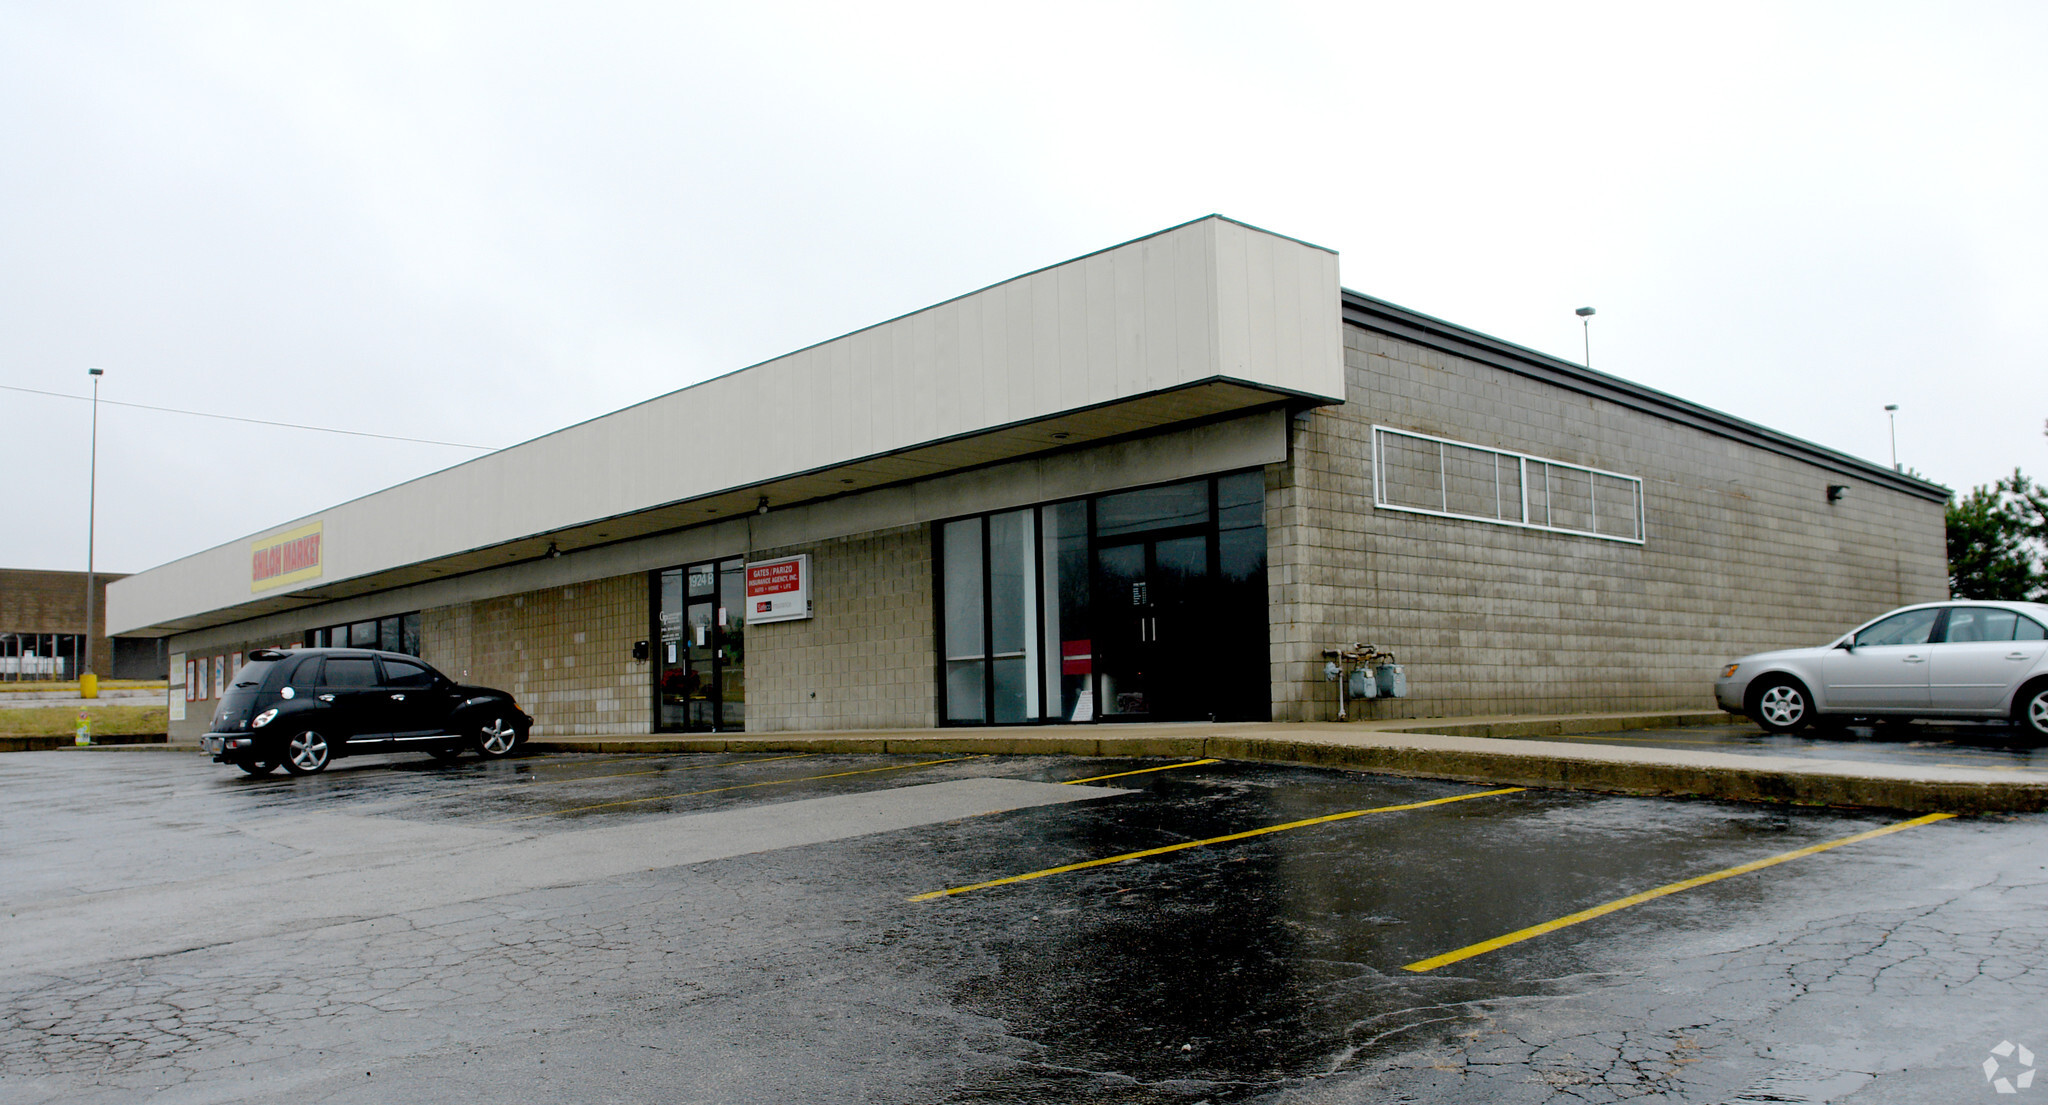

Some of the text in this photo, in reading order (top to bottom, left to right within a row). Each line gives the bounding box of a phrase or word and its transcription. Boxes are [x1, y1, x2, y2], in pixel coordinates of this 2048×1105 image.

[283, 531, 320, 574] MARKET
[753, 568, 769, 578] GATES
[689, 573, 714, 587] 1924 B
[748, 578, 771, 586] INSURANCE
